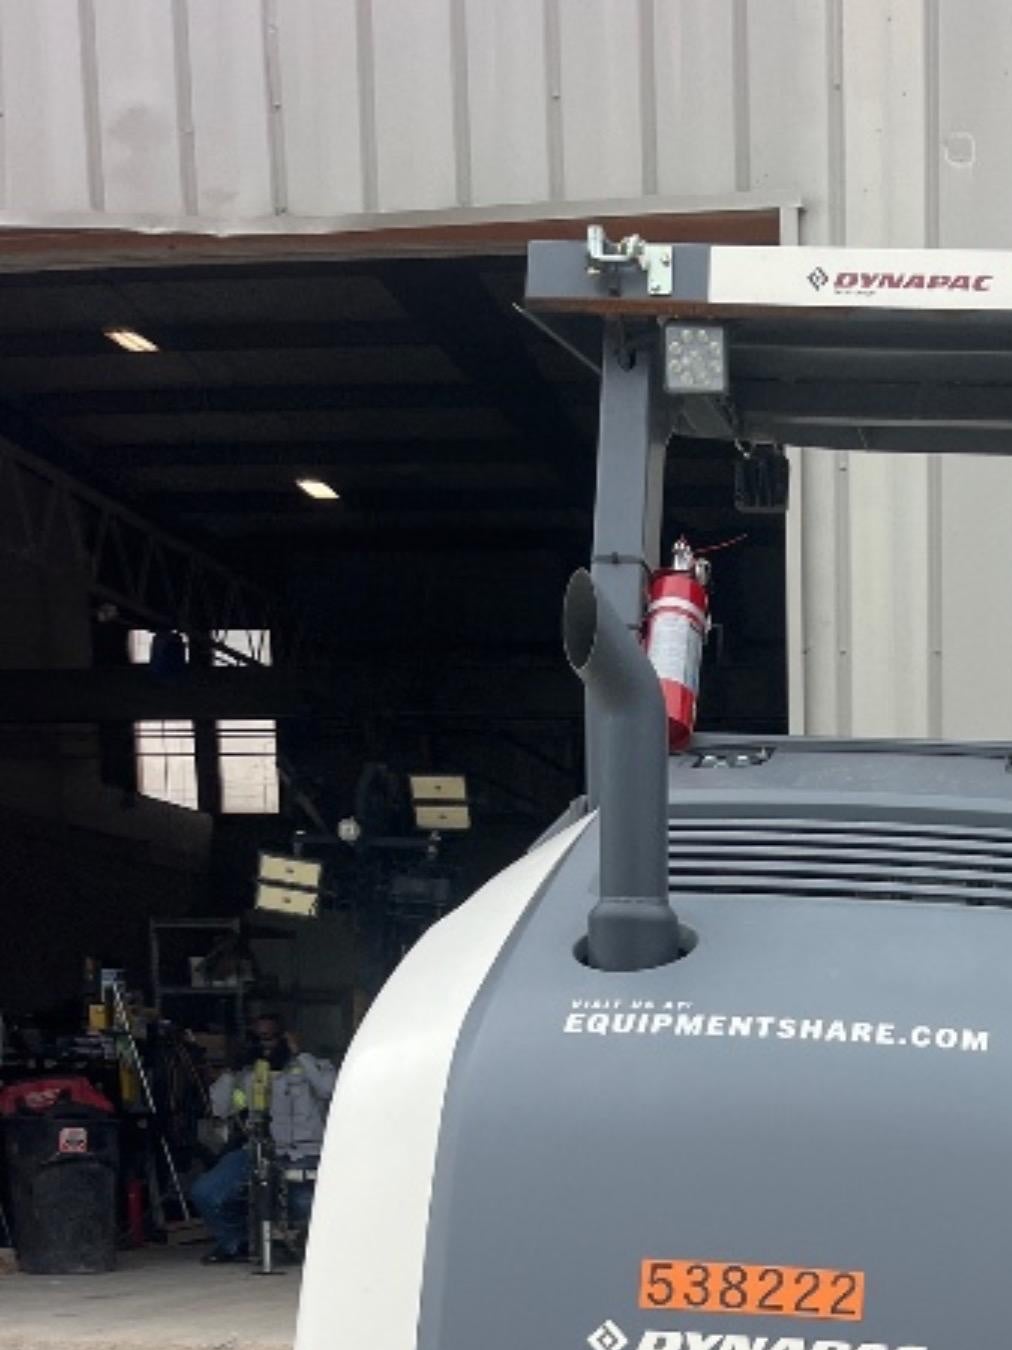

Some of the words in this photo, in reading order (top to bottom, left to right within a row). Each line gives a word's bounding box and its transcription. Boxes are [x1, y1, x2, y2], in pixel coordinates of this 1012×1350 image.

[833, 272, 994, 291] DYNAPAC
[563, 1012, 990, 1051] EQUIPMENTSHARE.COM
[646, 1262, 858, 1315] 538222
